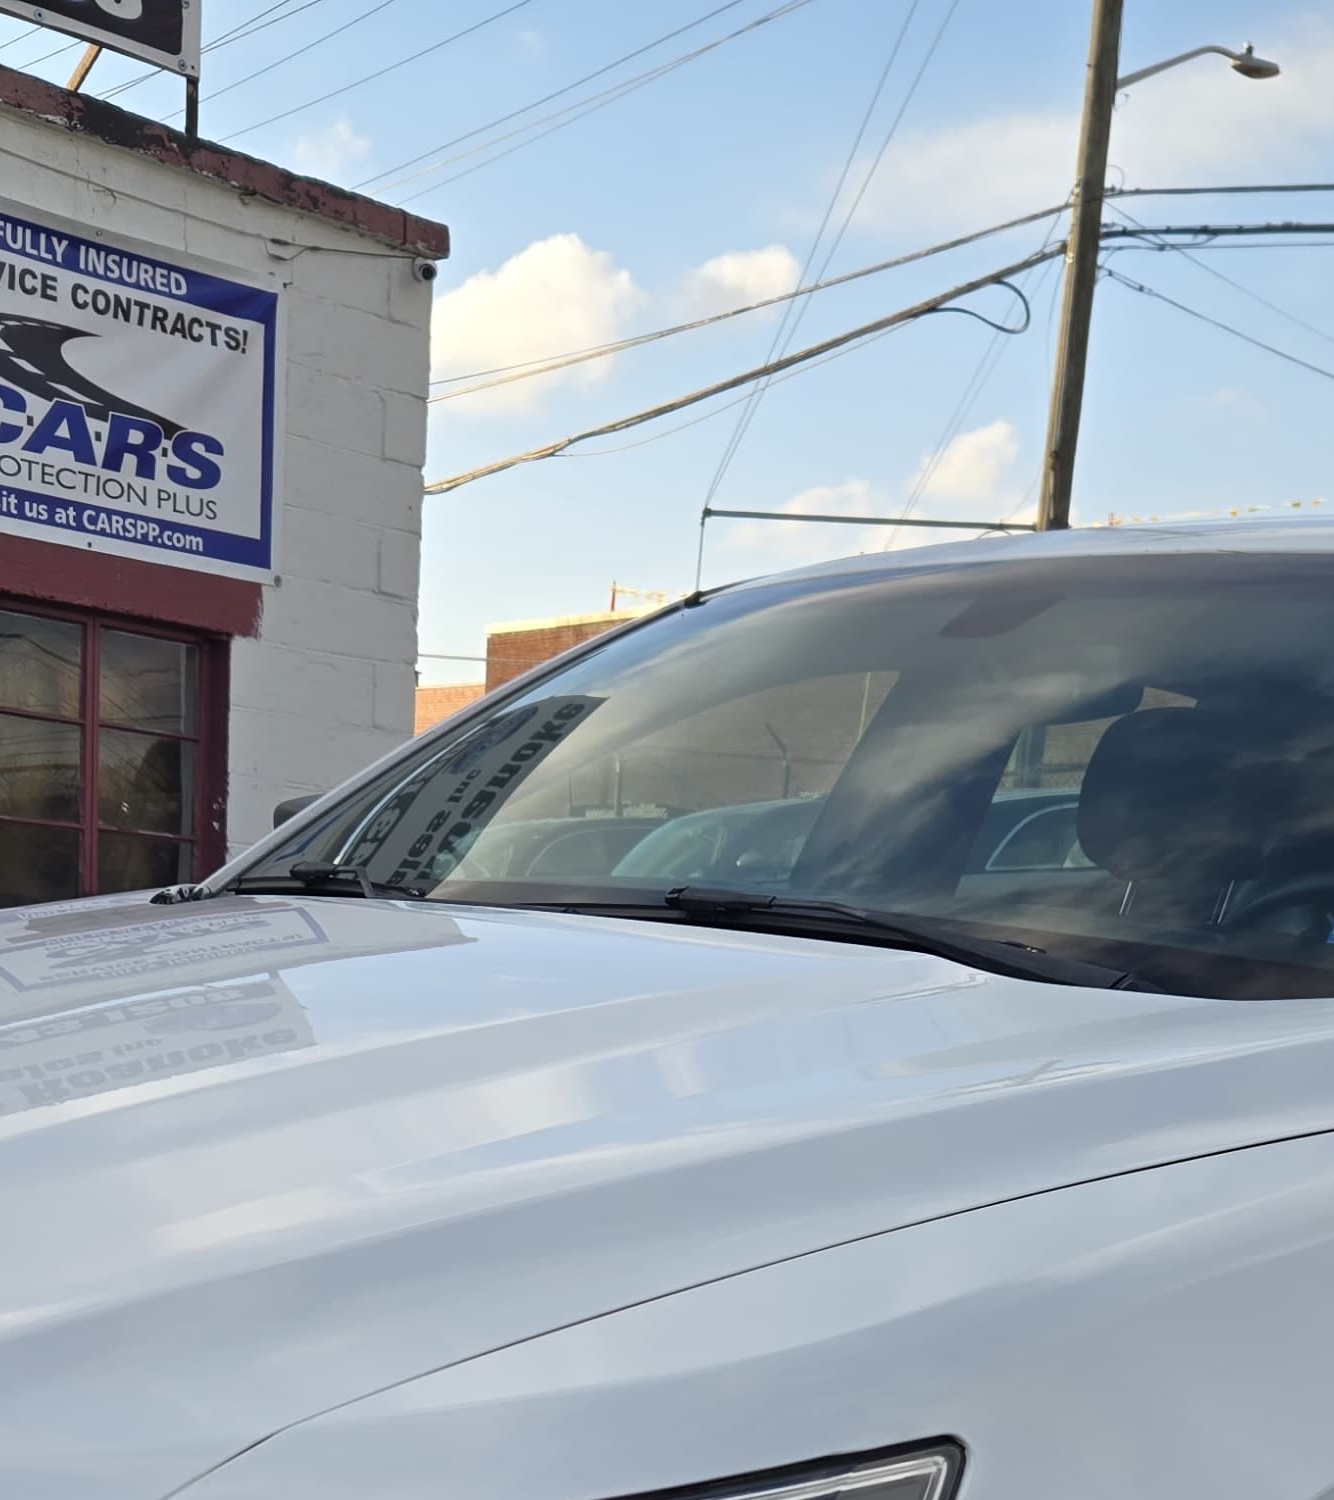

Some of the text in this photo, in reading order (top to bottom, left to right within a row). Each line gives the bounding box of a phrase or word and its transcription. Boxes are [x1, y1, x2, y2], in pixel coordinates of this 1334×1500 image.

[79, 244, 188, 296] INSURED
[70, 282, 249, 355] CONTRACTS!
[23, 501, 49, 521] us
[54, 505, 77, 527] at
[82, 509, 204, 552] CARSPP.com
[157, 488, 218, 520] PLUS
